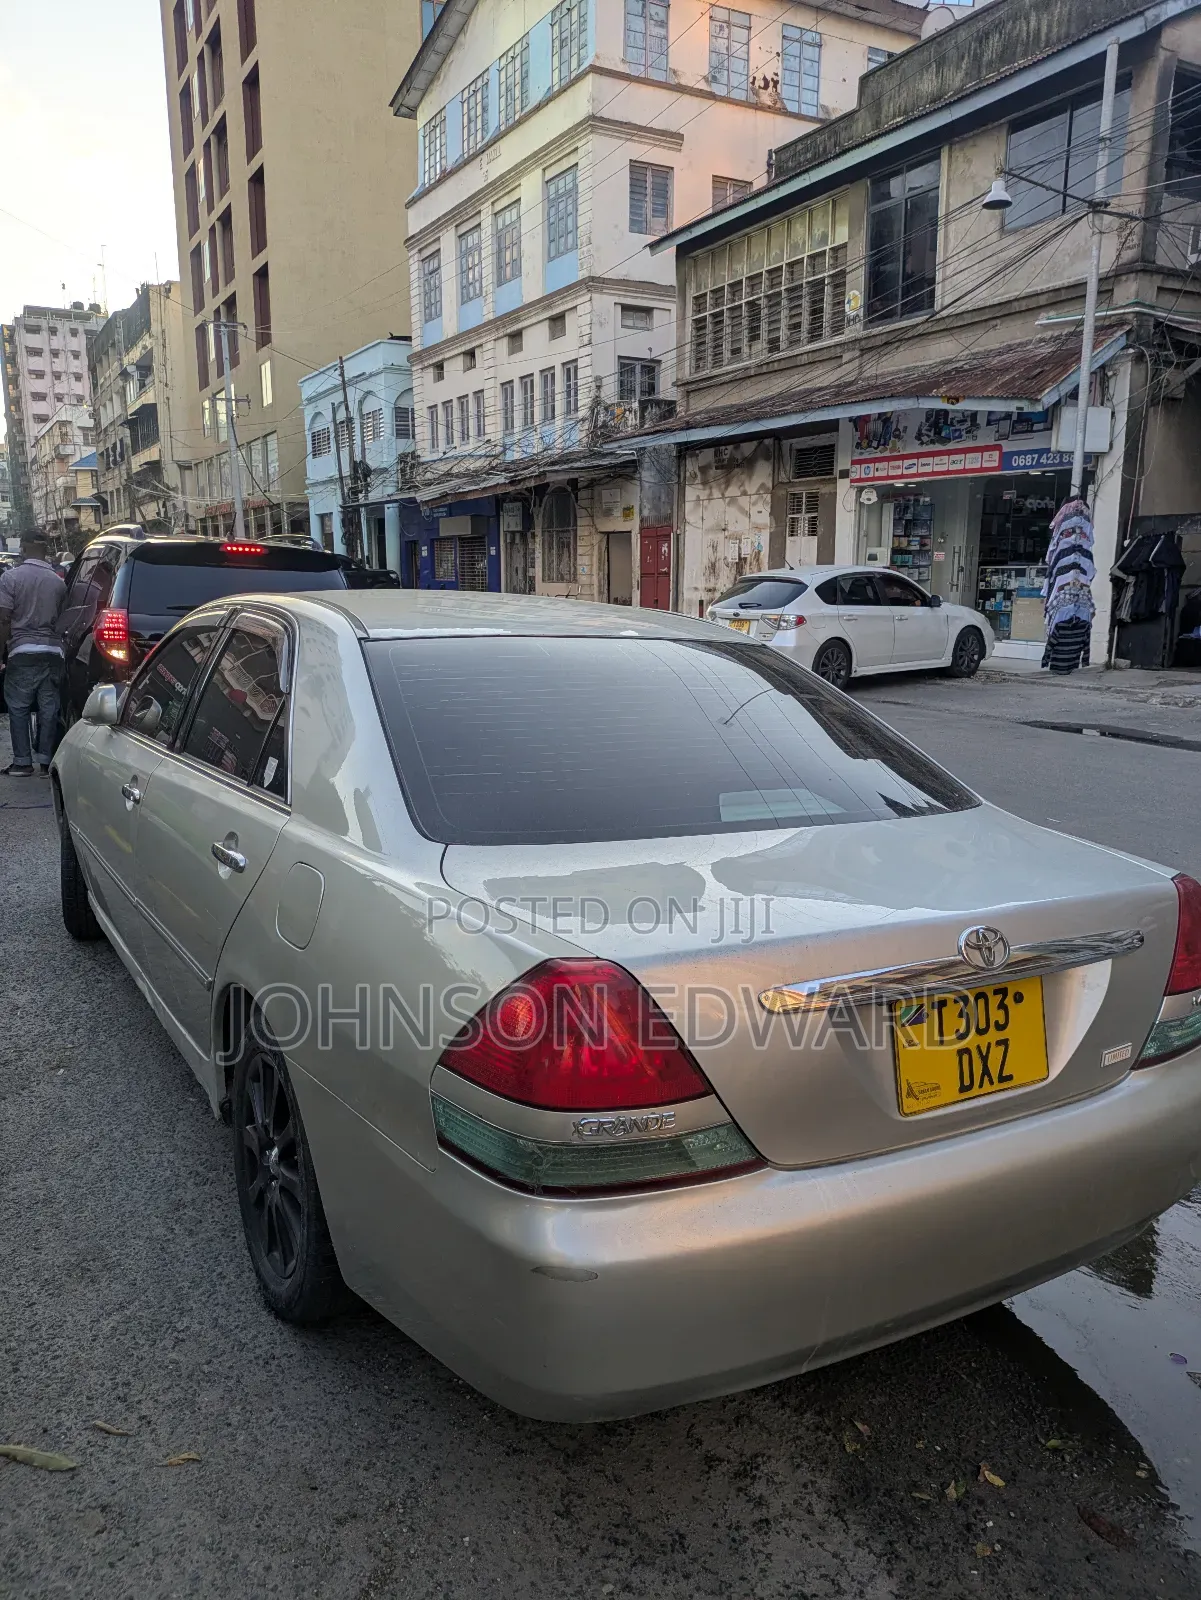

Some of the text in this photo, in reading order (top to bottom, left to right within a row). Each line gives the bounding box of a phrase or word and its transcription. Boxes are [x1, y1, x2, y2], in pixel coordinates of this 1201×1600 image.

[1012, 454, 1038, 466] 0687
[1040, 452, 1060, 464] 423
[931, 987, 1010, 1046] T303
[956, 1038, 1014, 1094] DXZ
[581, 1112, 676, 1137] GRANDE
